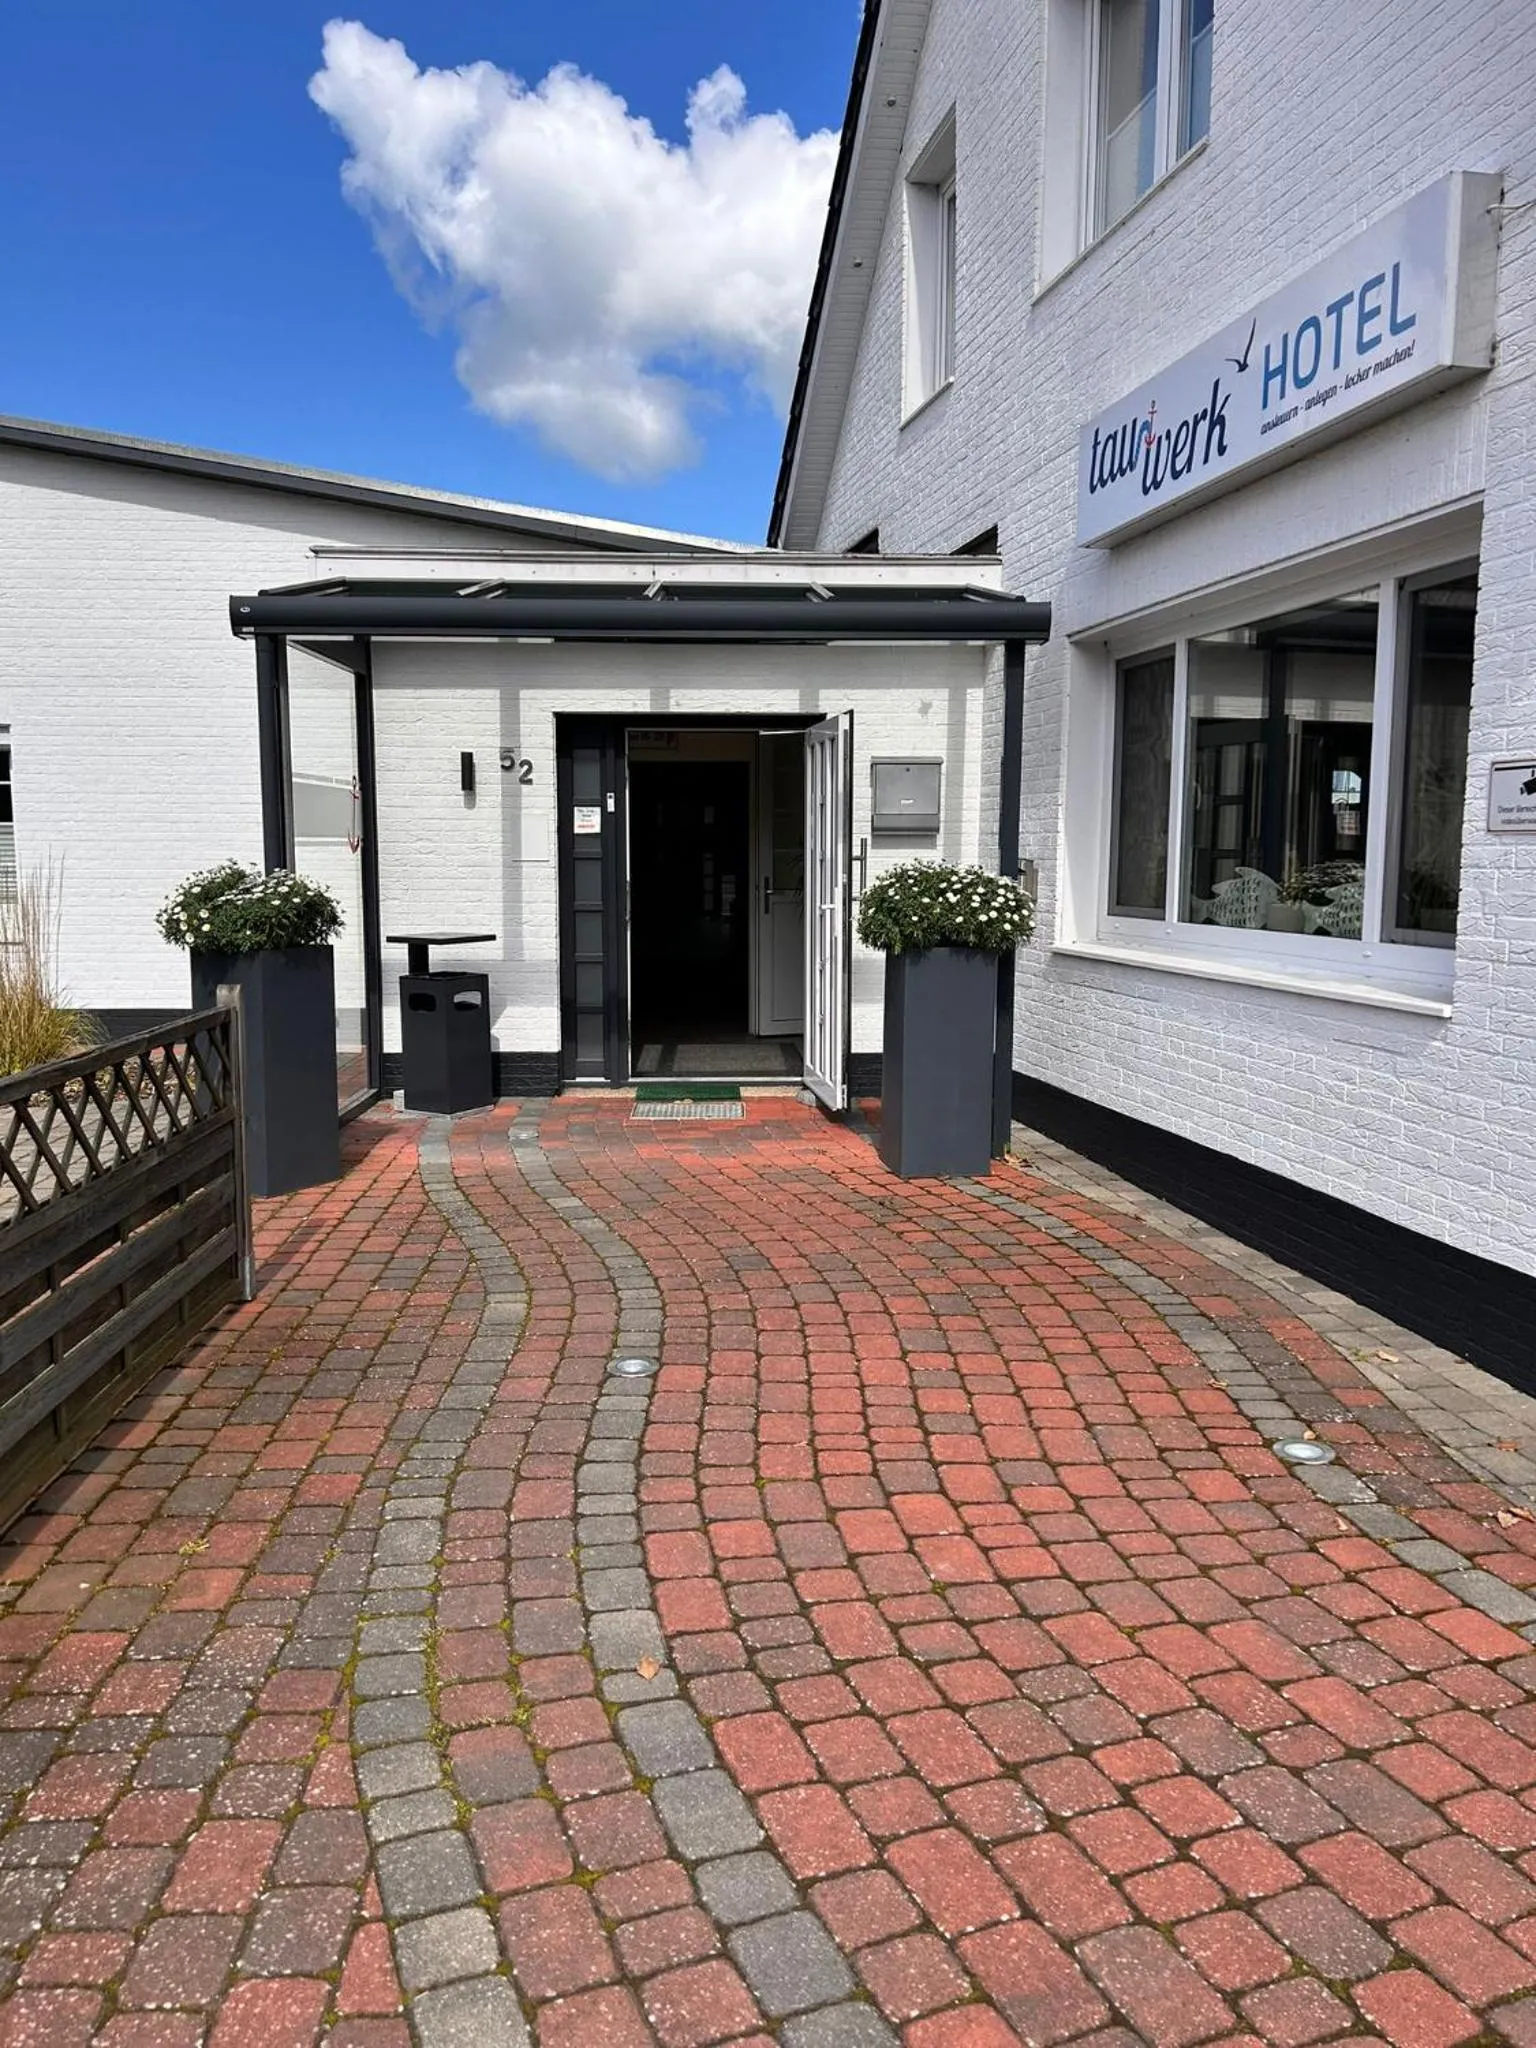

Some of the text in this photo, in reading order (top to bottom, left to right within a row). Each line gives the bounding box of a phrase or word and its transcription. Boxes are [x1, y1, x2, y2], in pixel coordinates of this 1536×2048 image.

[1261, 261, 1417, 411] HOTEL
[1304, 384, 1339, 412] anlegen
[1372, 338, 1416, 377] machen!
[499, 750, 534, 786] 52
